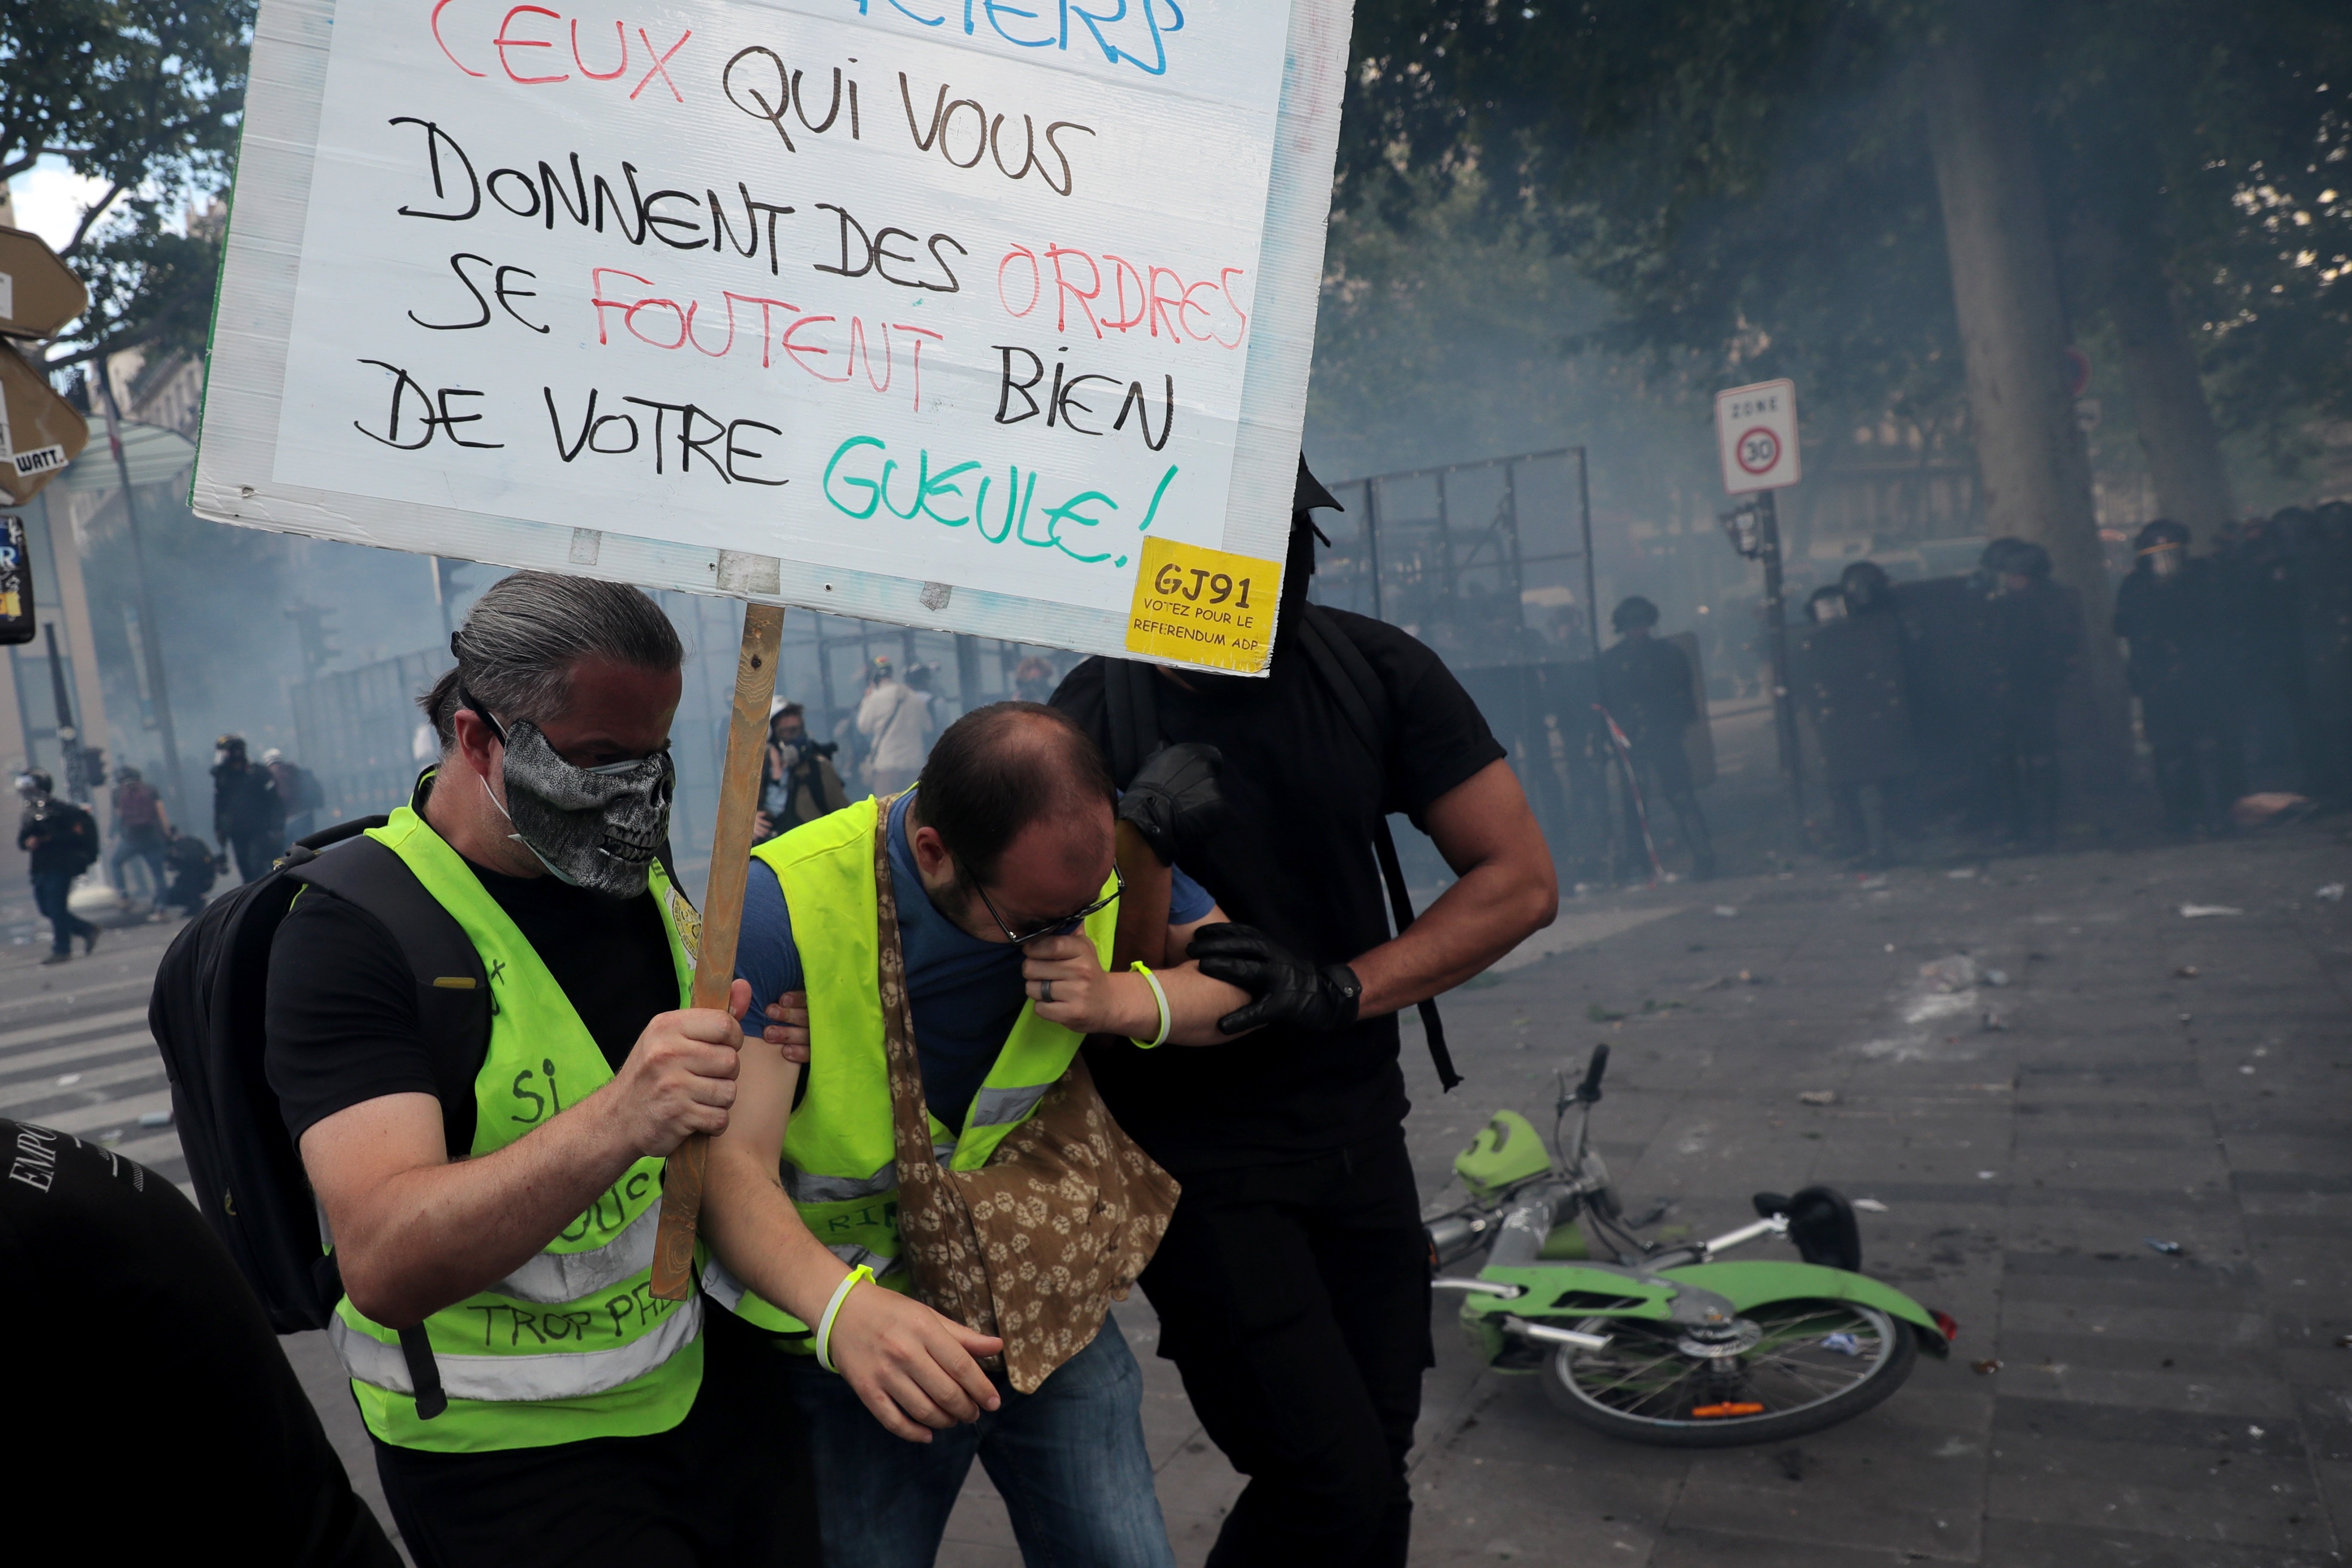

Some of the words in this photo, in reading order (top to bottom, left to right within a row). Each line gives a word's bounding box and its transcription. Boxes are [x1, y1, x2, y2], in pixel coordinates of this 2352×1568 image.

[431, 0, 692, 102] CEUX
[898, 71, 1096, 196] VOUS
[388, 117, 795, 276] DONNENT
[813, 203, 968, 293] DES
[998, 242, 1246, 350] ORDRES
[407, 253, 550, 333] SE
[591, 267, 945, 412] FOUTENT
[354, 358, 505, 450] DE
[543, 386, 790, 486] VOTRE
[1730, 395, 1779, 420] ZONE
[1746, 439, 1774, 462] 30
[1155, 563, 1251, 609] GJ91
[1133, 619, 1226, 646] REFERENDUM
[1231, 638, 1259, 651] ADP
[1144, 598, 1191, 617] VOTEZ
[1195, 607, 1232, 624] POUR
[1237, 615, 1254, 629] LE
[467, 1304, 591, 1347] TROP
